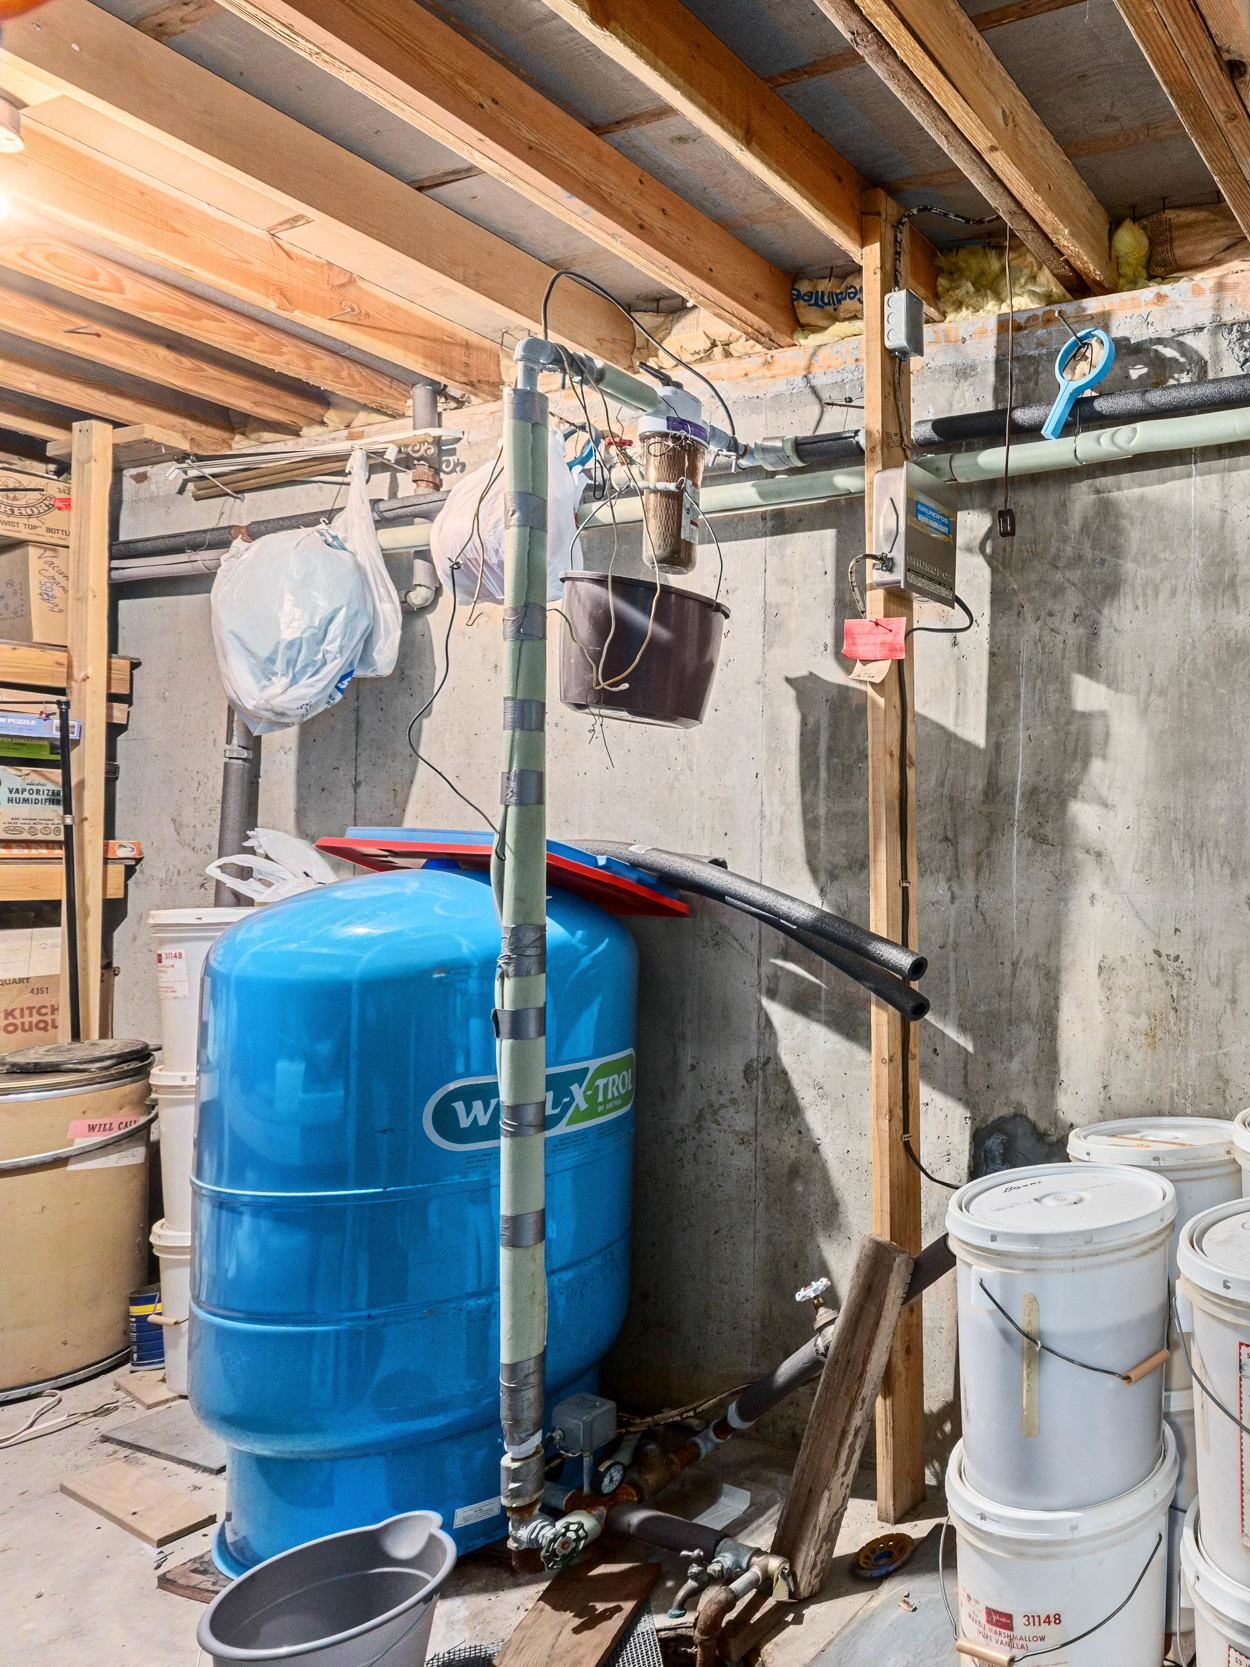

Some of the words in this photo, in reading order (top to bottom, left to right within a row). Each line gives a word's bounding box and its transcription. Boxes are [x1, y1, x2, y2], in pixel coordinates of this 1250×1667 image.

[8, 787, 62, 797] VAPORIZER
[7, 796, 62, 806] HUMIDIFIER
[0, 977, 31, 986] QUART
[452, 1069, 634, 1129] WL-X-TROL
[87, 1122, 114, 1133] WILL
[1022, 1613, 1062, 1627] 31148
[988, 1627, 1046, 1642] MARSHMALLOW
[995, 1639, 1029, 1651] VANILLA)
